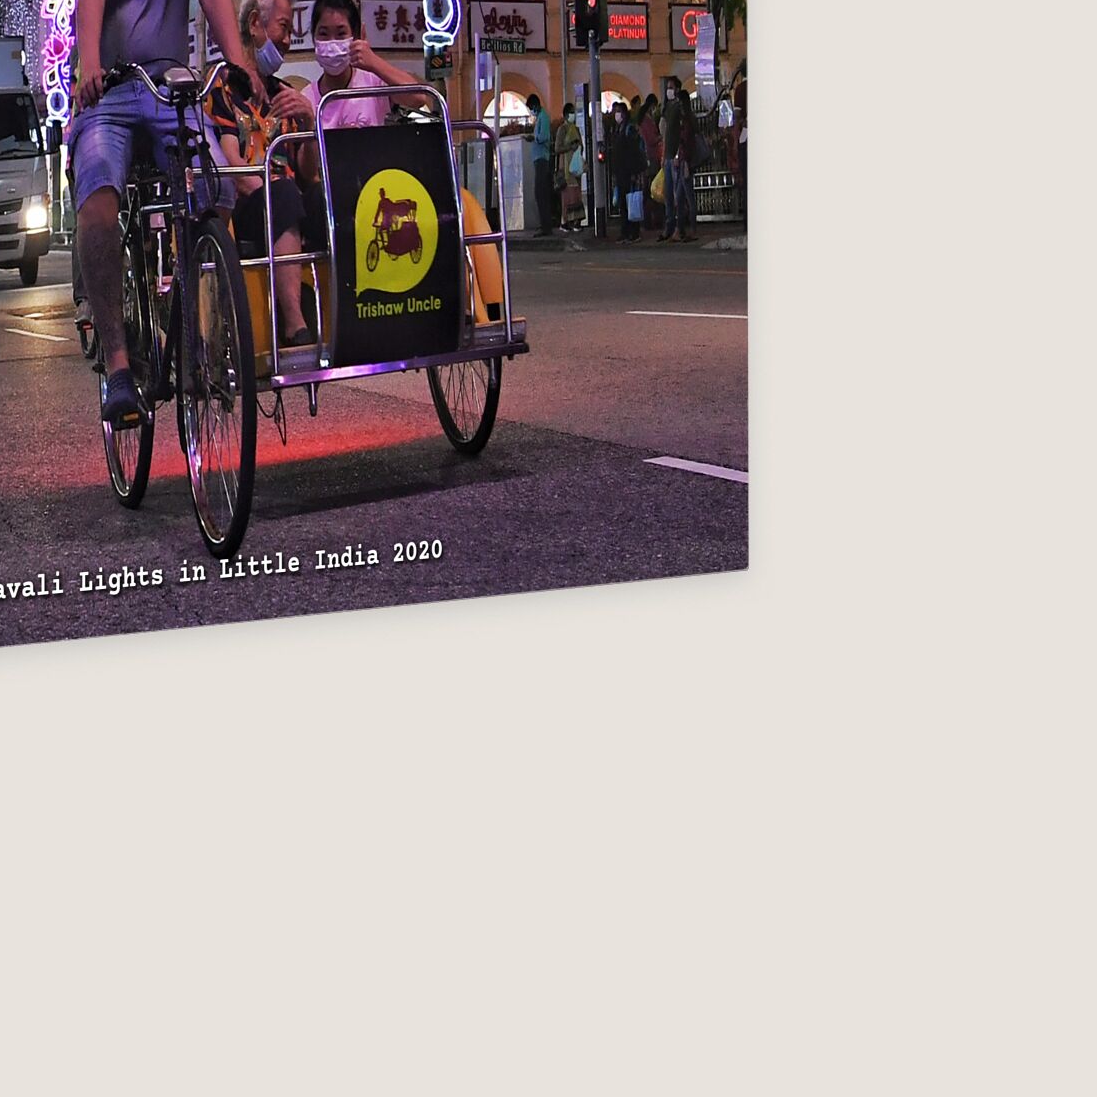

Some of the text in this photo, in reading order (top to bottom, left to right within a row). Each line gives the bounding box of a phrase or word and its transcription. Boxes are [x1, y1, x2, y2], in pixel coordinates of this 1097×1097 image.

[609, 13, 647, 26] DIAMOND
[608, 27, 647, 40] PLATINUM
[513, 41, 524, 54] Rd
[356, 295, 442, 319] Trishaw Uncle
